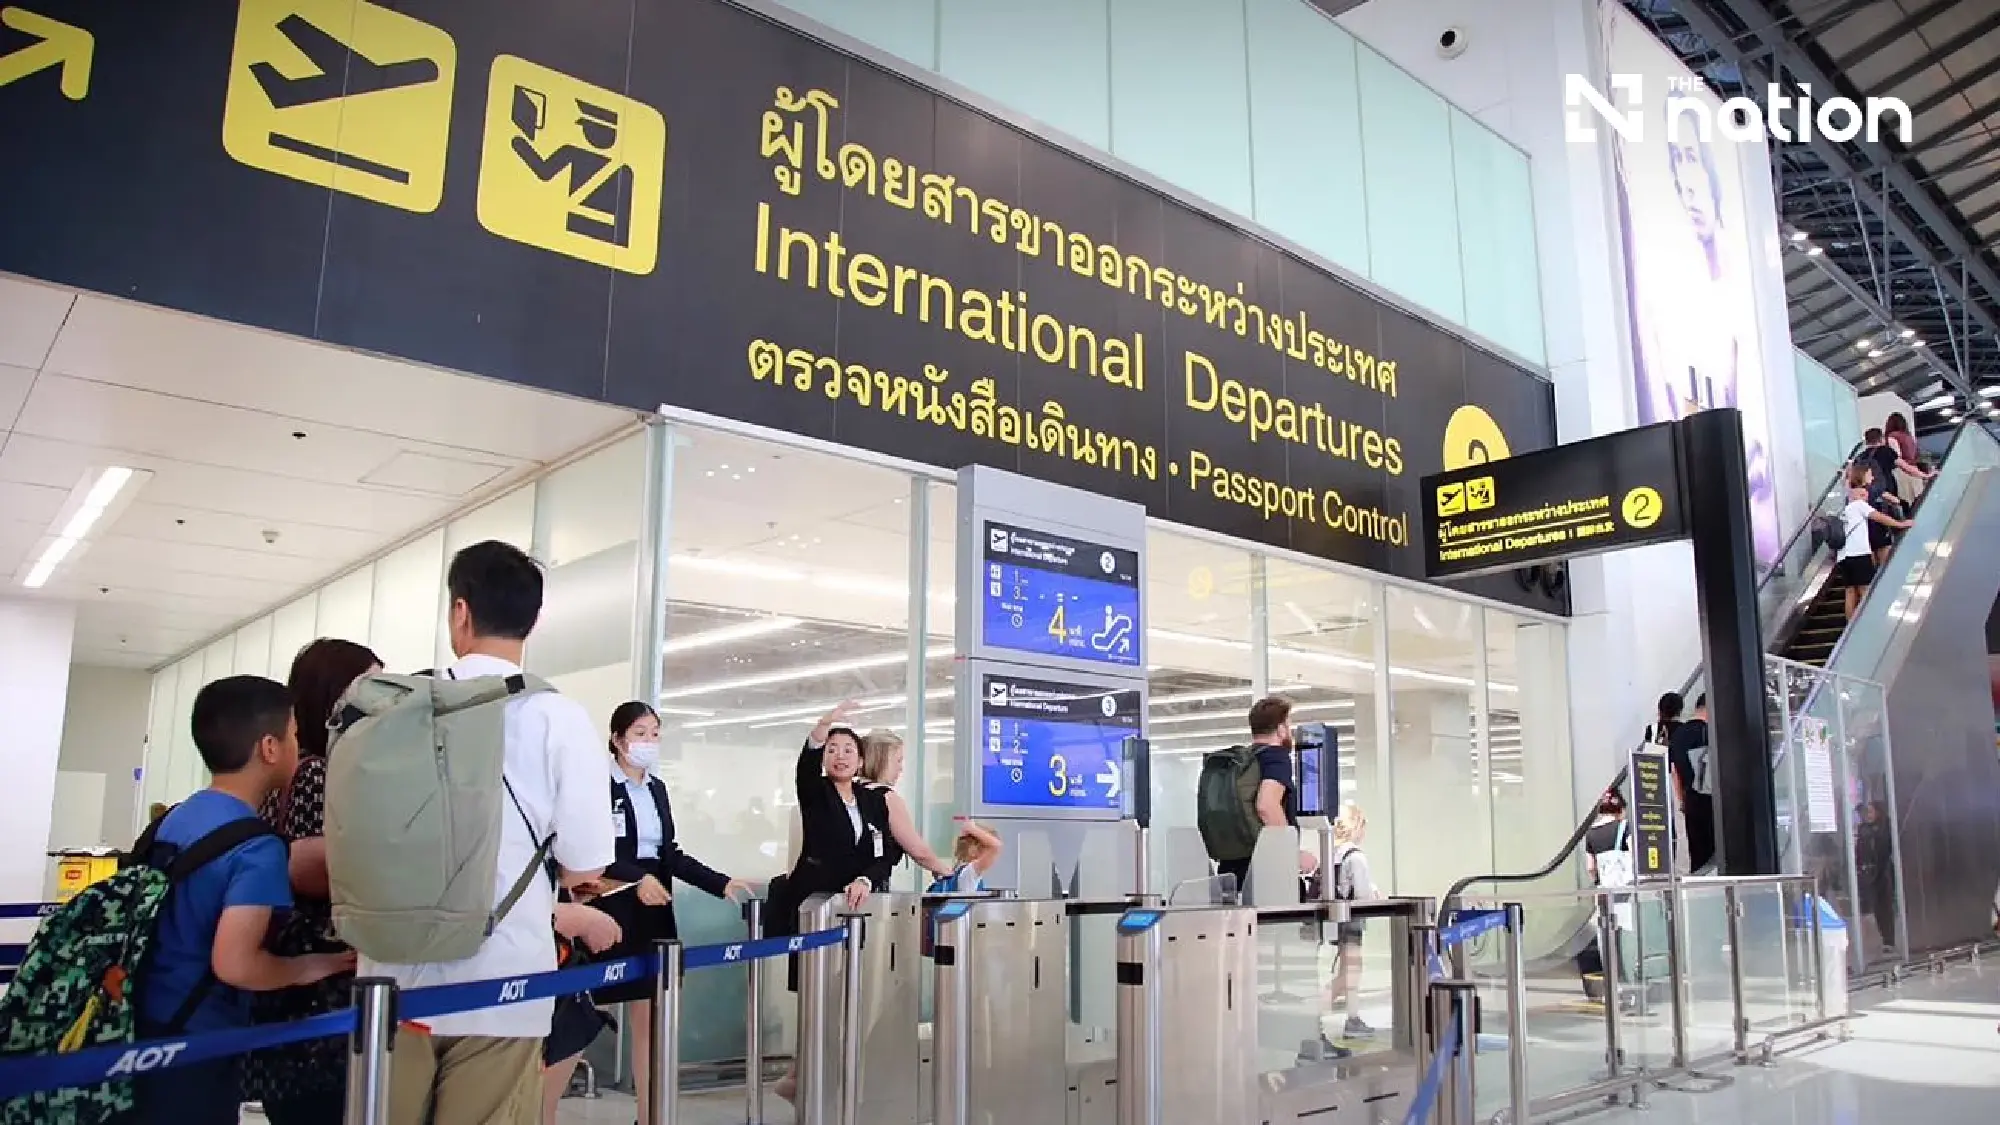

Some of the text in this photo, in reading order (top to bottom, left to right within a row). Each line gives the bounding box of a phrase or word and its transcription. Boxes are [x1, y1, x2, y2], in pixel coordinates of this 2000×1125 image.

[760, 85, 1398, 398] ผู้โดยสารขาออกระหว่างประเทศ
[754, 201, 1404, 476] International Departures
[747, 338, 1409, 547] ตรวจหนังสือเดินทาง Passport Control
[1633, 493, 1652, 521] 2
[1439, 540, 1503, 561] International
[1505, 527, 1566, 549] Departures
[1048, 605, 1067, 645] 4
[1049, 754, 1067, 796] 3
[723, 945, 743, 961] AOT
[788, 936, 804, 950] AOT
[604, 962, 627, 982] AOT
[498, 979, 529, 1003] AOT
[105, 1042, 188, 1077] AOT
